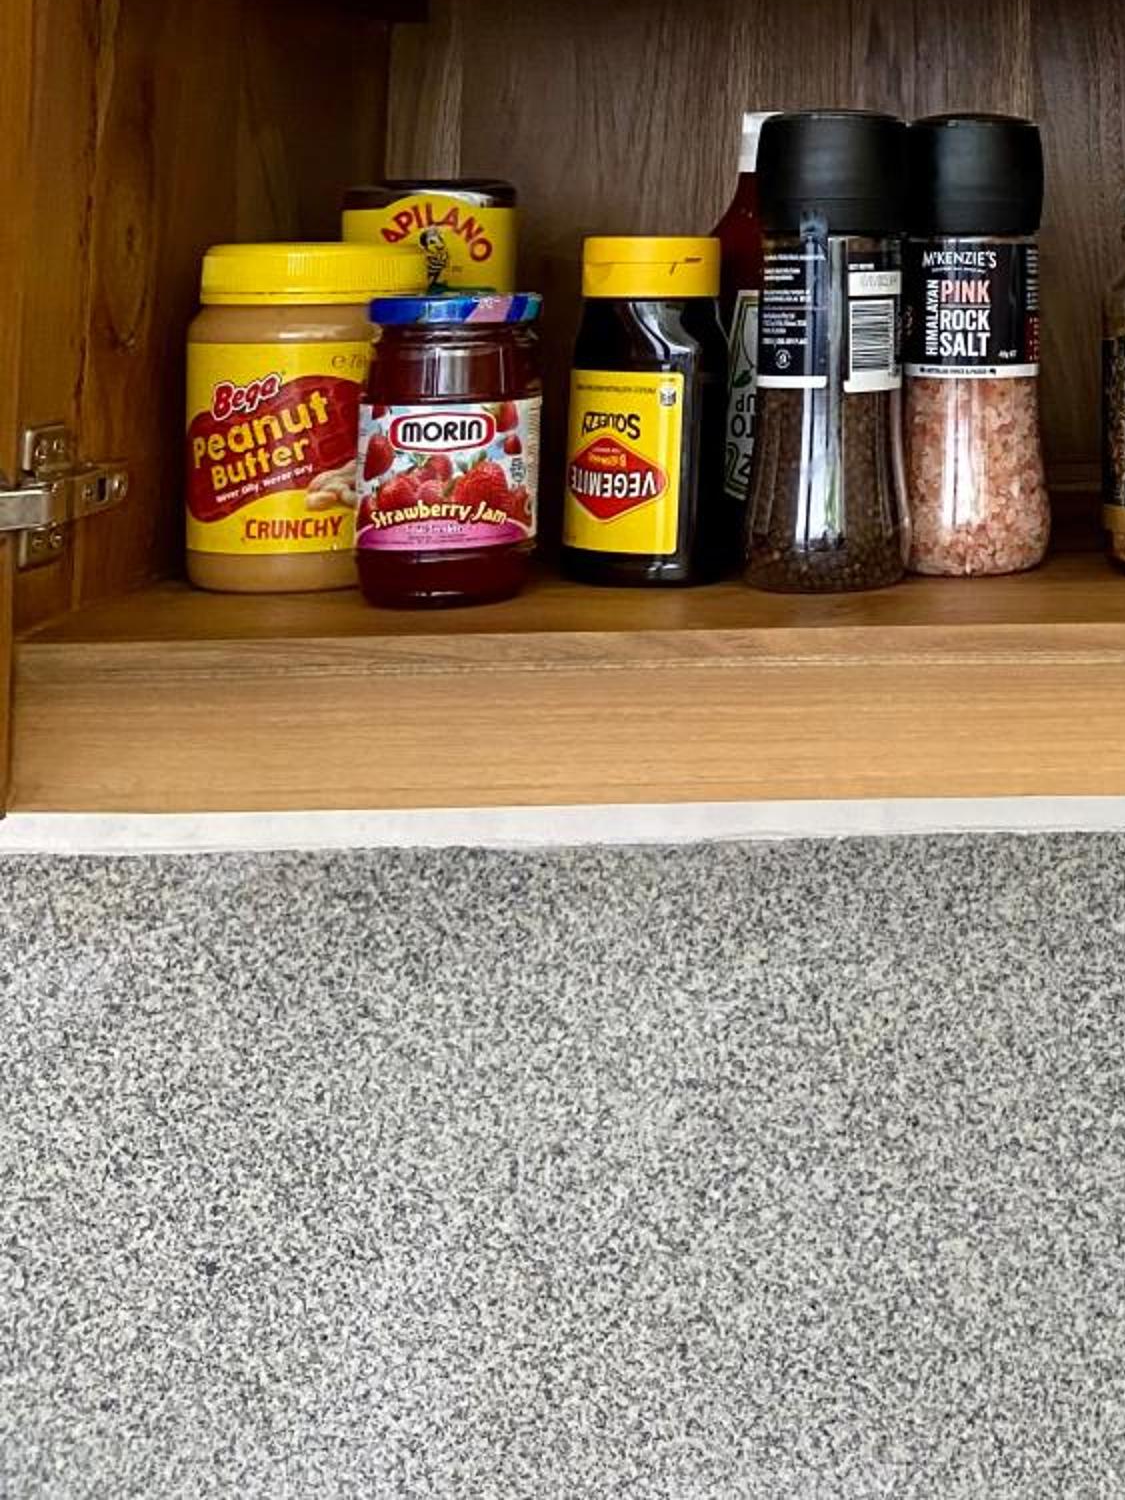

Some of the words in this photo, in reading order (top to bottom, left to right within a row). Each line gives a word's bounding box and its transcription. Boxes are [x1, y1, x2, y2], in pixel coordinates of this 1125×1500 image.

[381, 201, 493, 262] APILANO
[940, 279, 991, 303] PINK
[925, 279, 940, 356] HIMALAYAN
[940, 309, 991, 331] ROCK
[939, 331, 991, 357] SALT
[212, 373, 281, 420] Bega
[193, 390, 329, 469] Peanut
[211, 438, 311, 491] Butter
[571, 466, 658, 499] VEGEMITE
[245, 515, 343, 540] CRUNCHY
[370, 500, 472, 529] Strawberry
[470, 500, 507, 524] Jam
